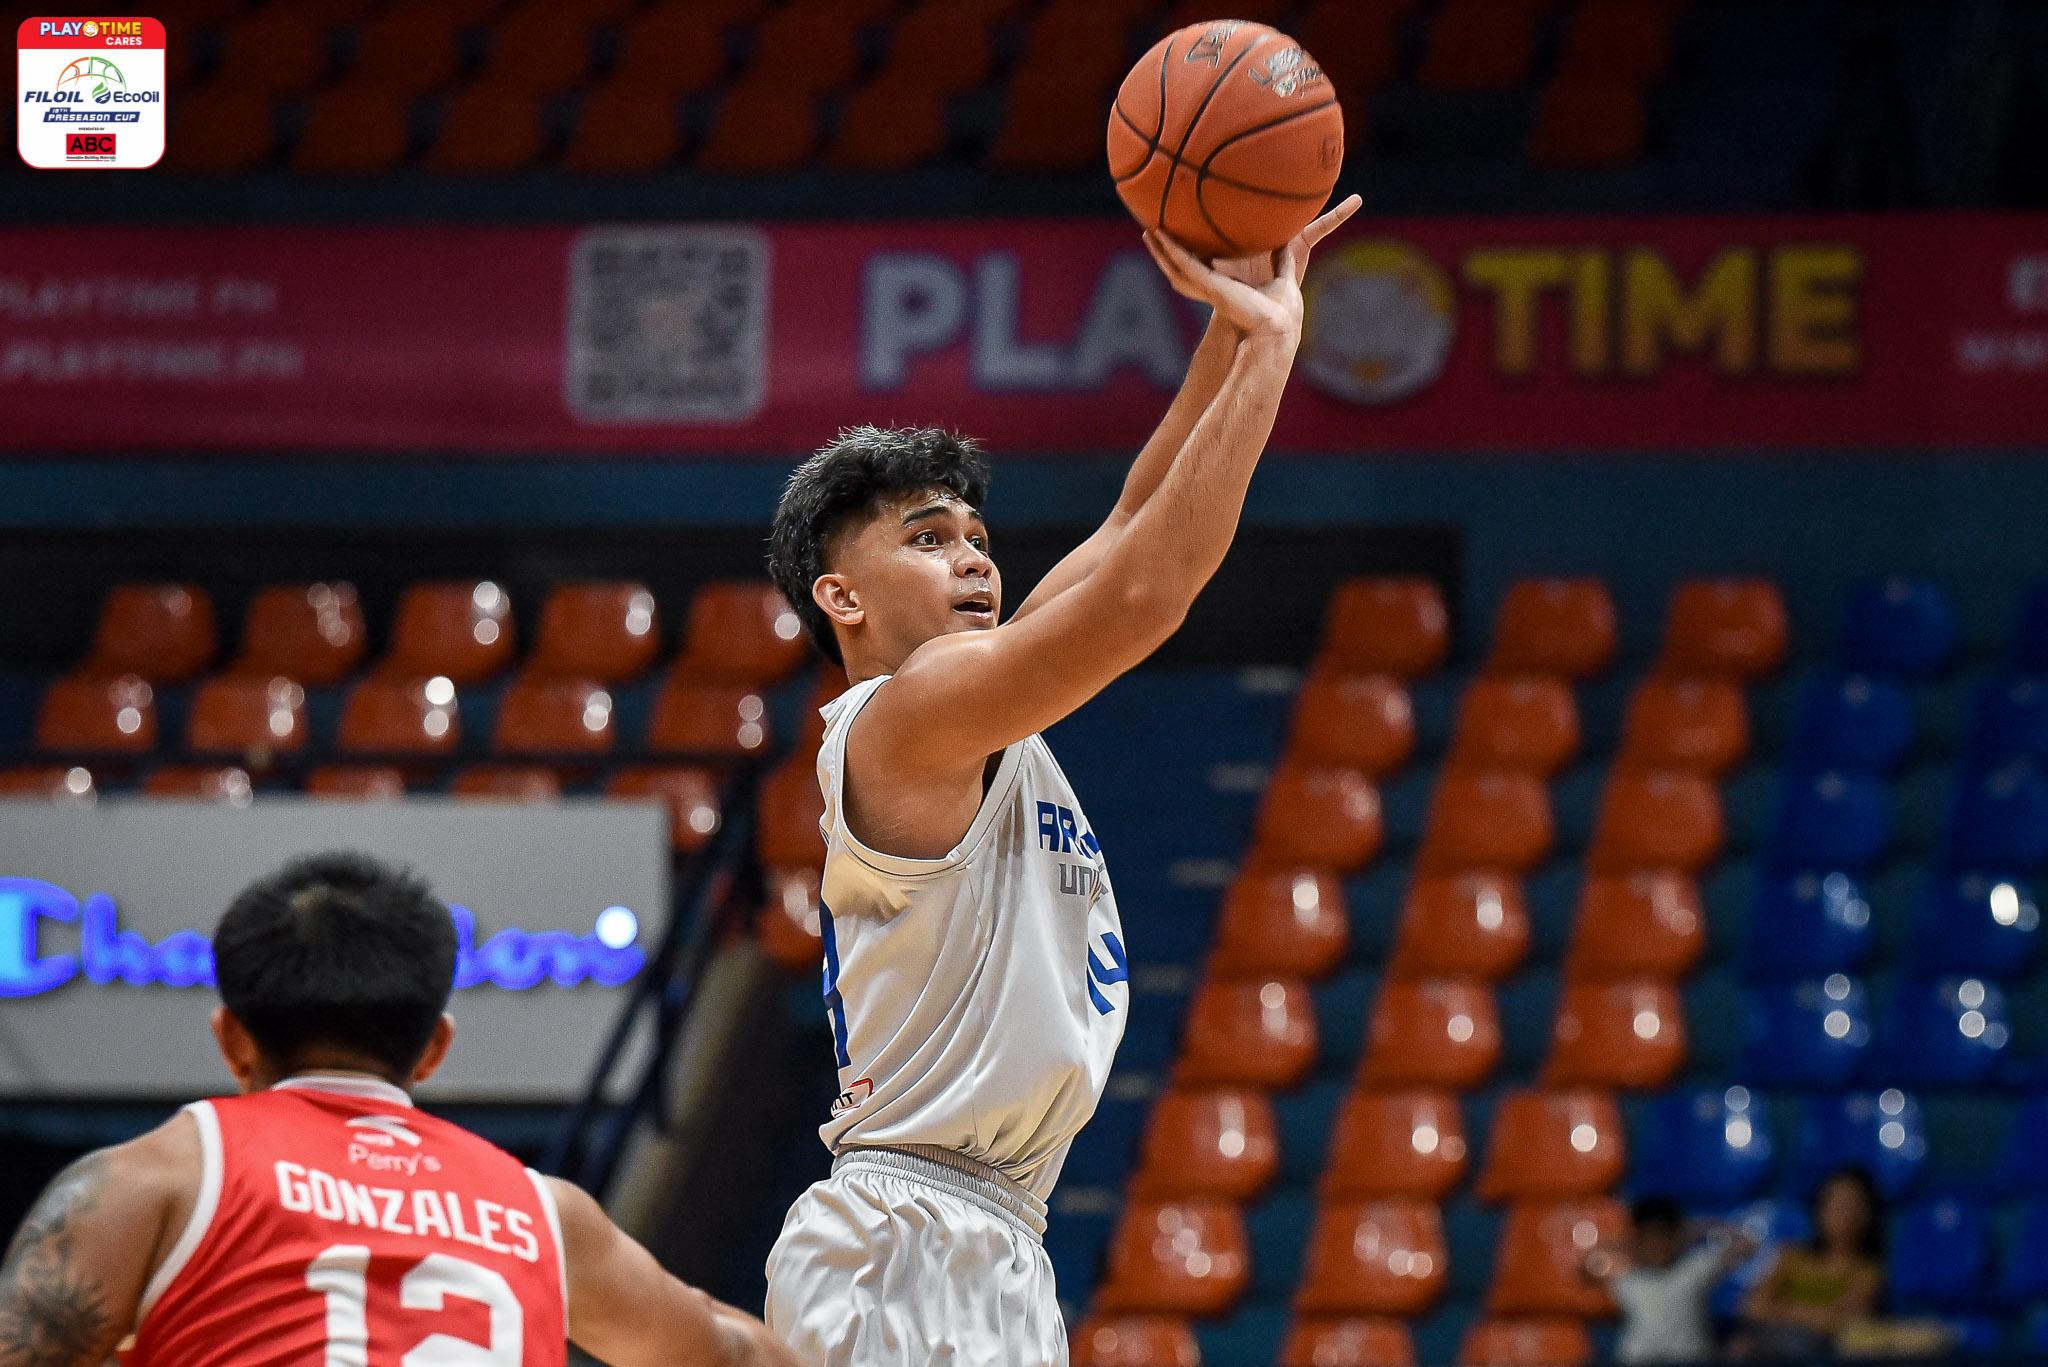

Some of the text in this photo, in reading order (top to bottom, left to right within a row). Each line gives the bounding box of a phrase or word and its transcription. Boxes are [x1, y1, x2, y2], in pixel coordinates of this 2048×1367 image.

[858, 248, 1215, 391] PLA
[1468, 248, 1858, 374] TIME
[347, 1142, 442, 1176] Perry's
[274, 1160, 539, 1263] GONZALES
